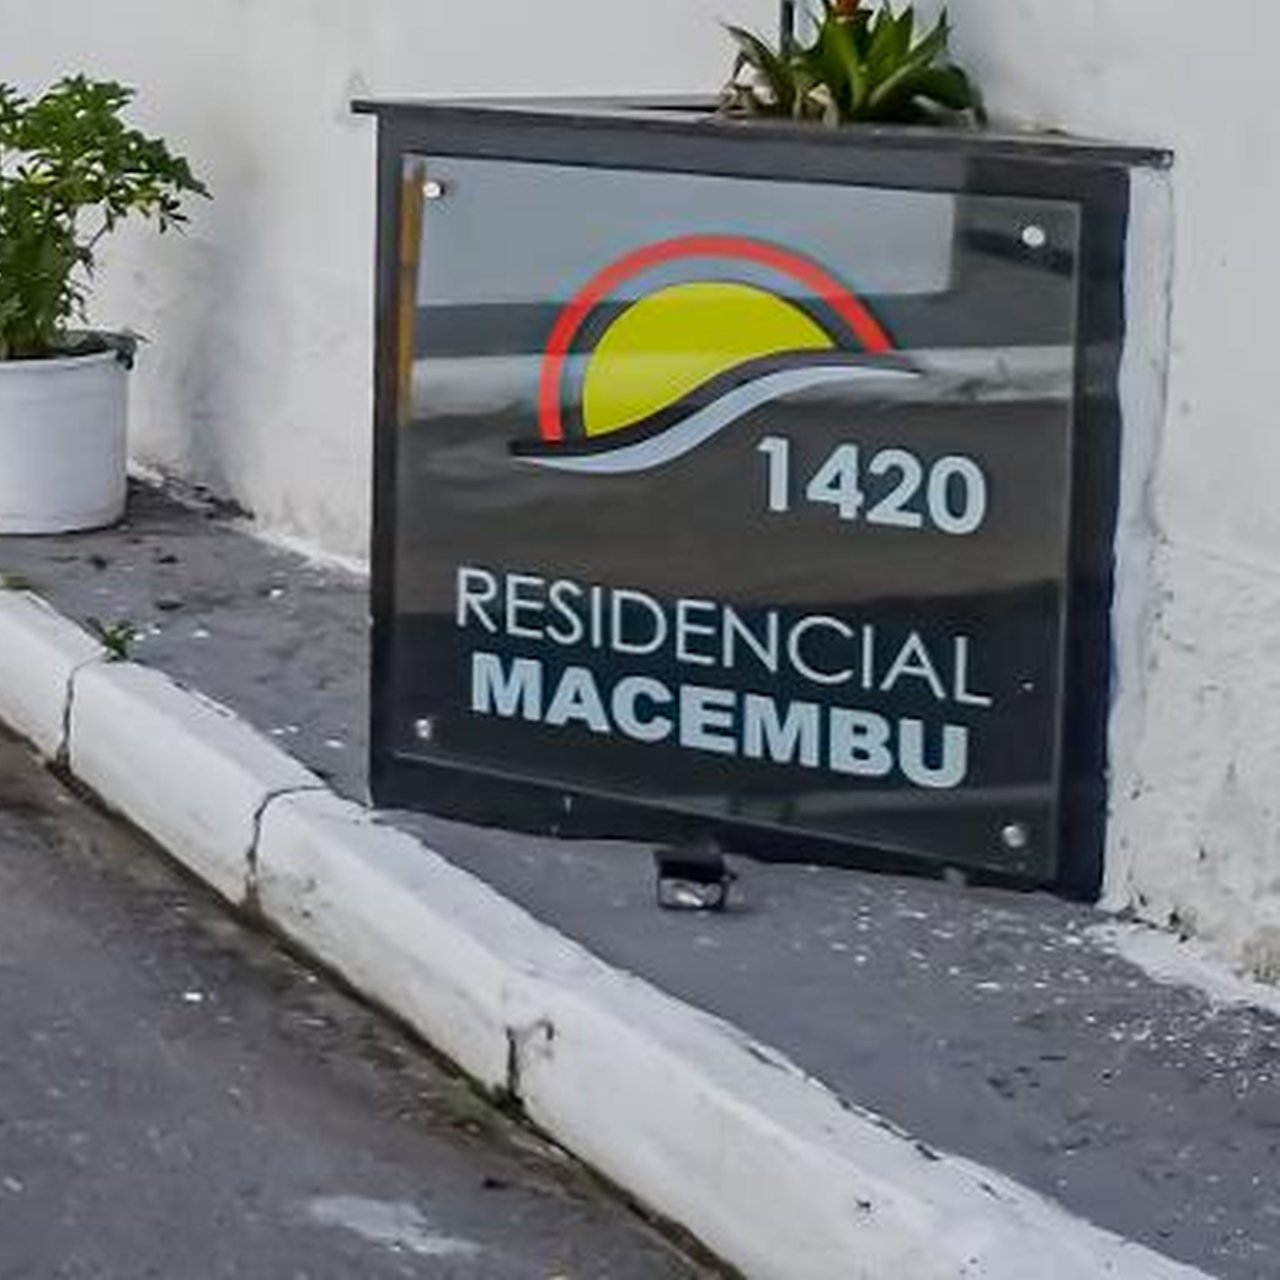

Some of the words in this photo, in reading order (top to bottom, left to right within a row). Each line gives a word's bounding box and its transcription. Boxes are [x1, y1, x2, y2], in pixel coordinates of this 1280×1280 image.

[754, 436, 988, 535] 1420
[455, 566, 993, 707] RESIDENCIAL
[470, 651, 970, 790] MACEMBU
